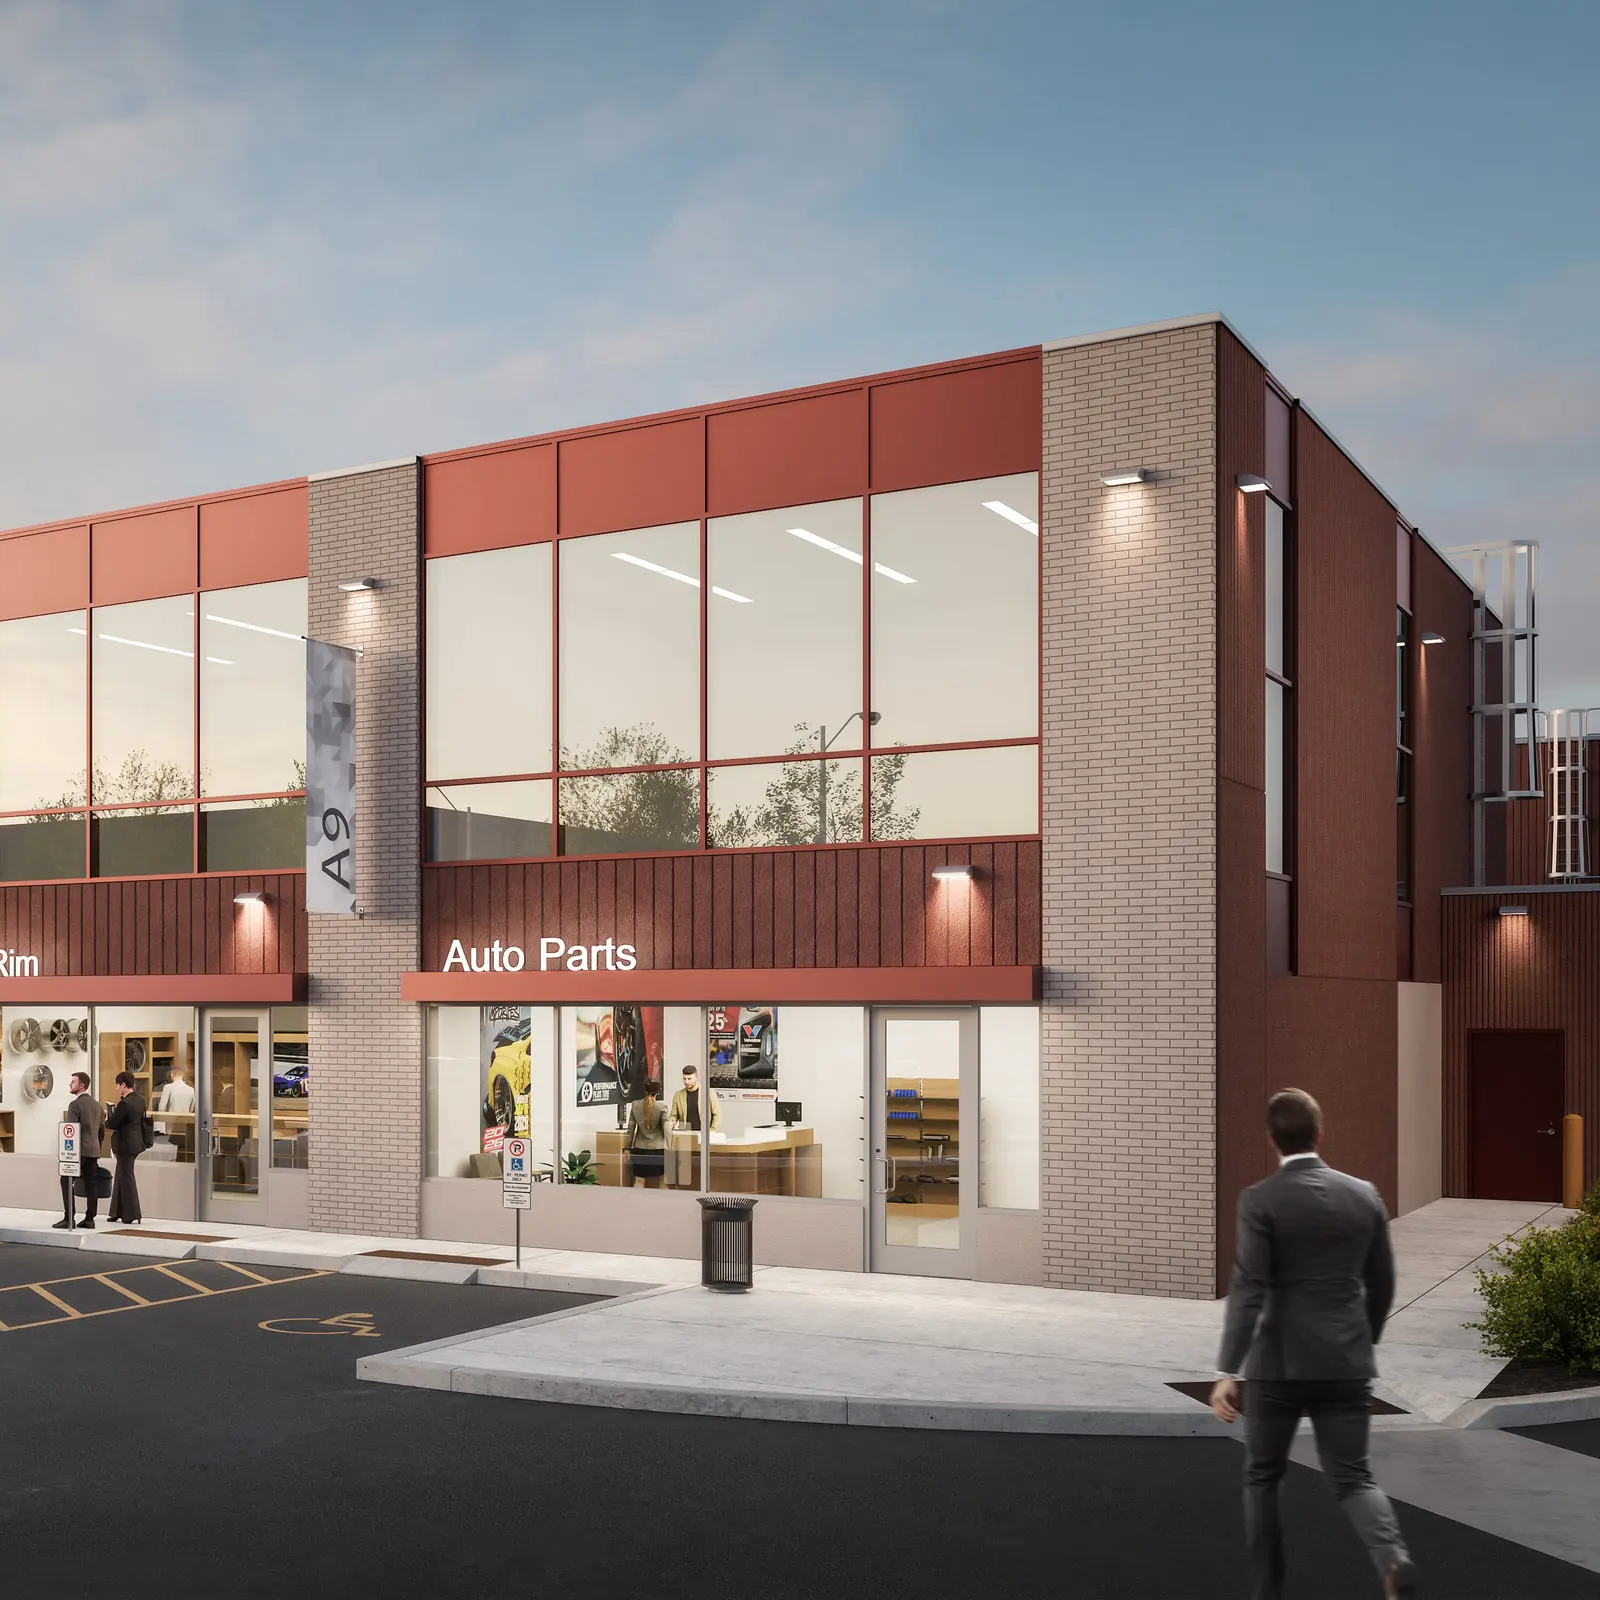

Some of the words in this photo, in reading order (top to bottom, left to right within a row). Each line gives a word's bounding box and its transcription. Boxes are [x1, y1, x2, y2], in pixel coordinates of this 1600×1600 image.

[321, 806, 351, 890] A9
[442, 938, 525, 973] Auto
[540, 937, 637, 972] Parts
